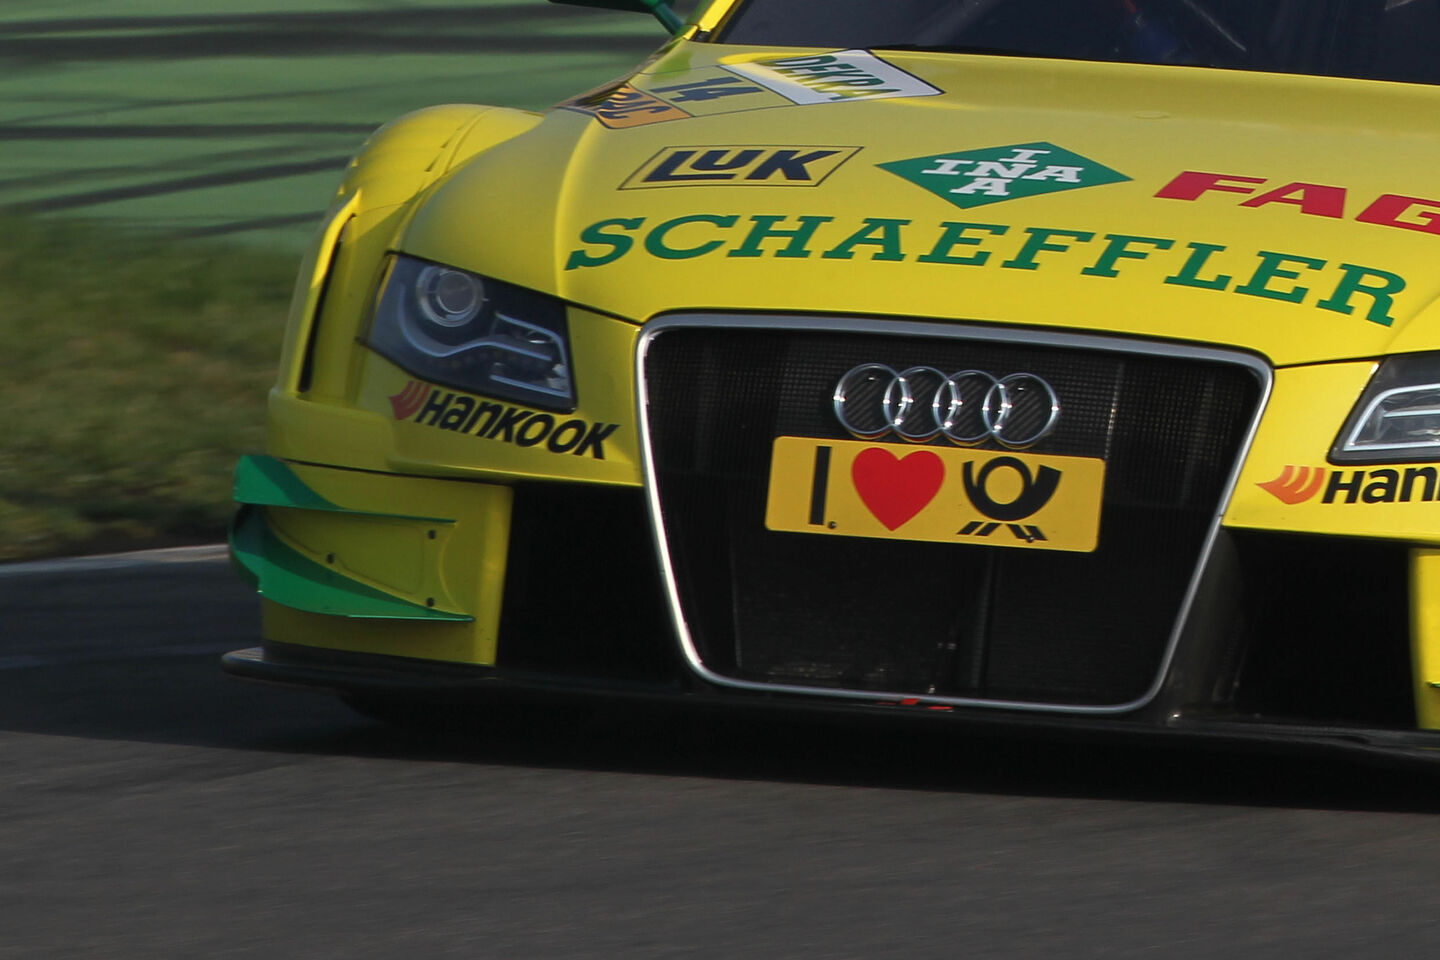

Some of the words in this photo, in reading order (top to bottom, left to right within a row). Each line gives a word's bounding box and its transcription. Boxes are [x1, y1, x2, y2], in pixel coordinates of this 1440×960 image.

[648, 76, 765, 103] 14
[755, 54, 902, 101] DEKRA
[563, 214, 1407, 328] SCHAEFFLER
